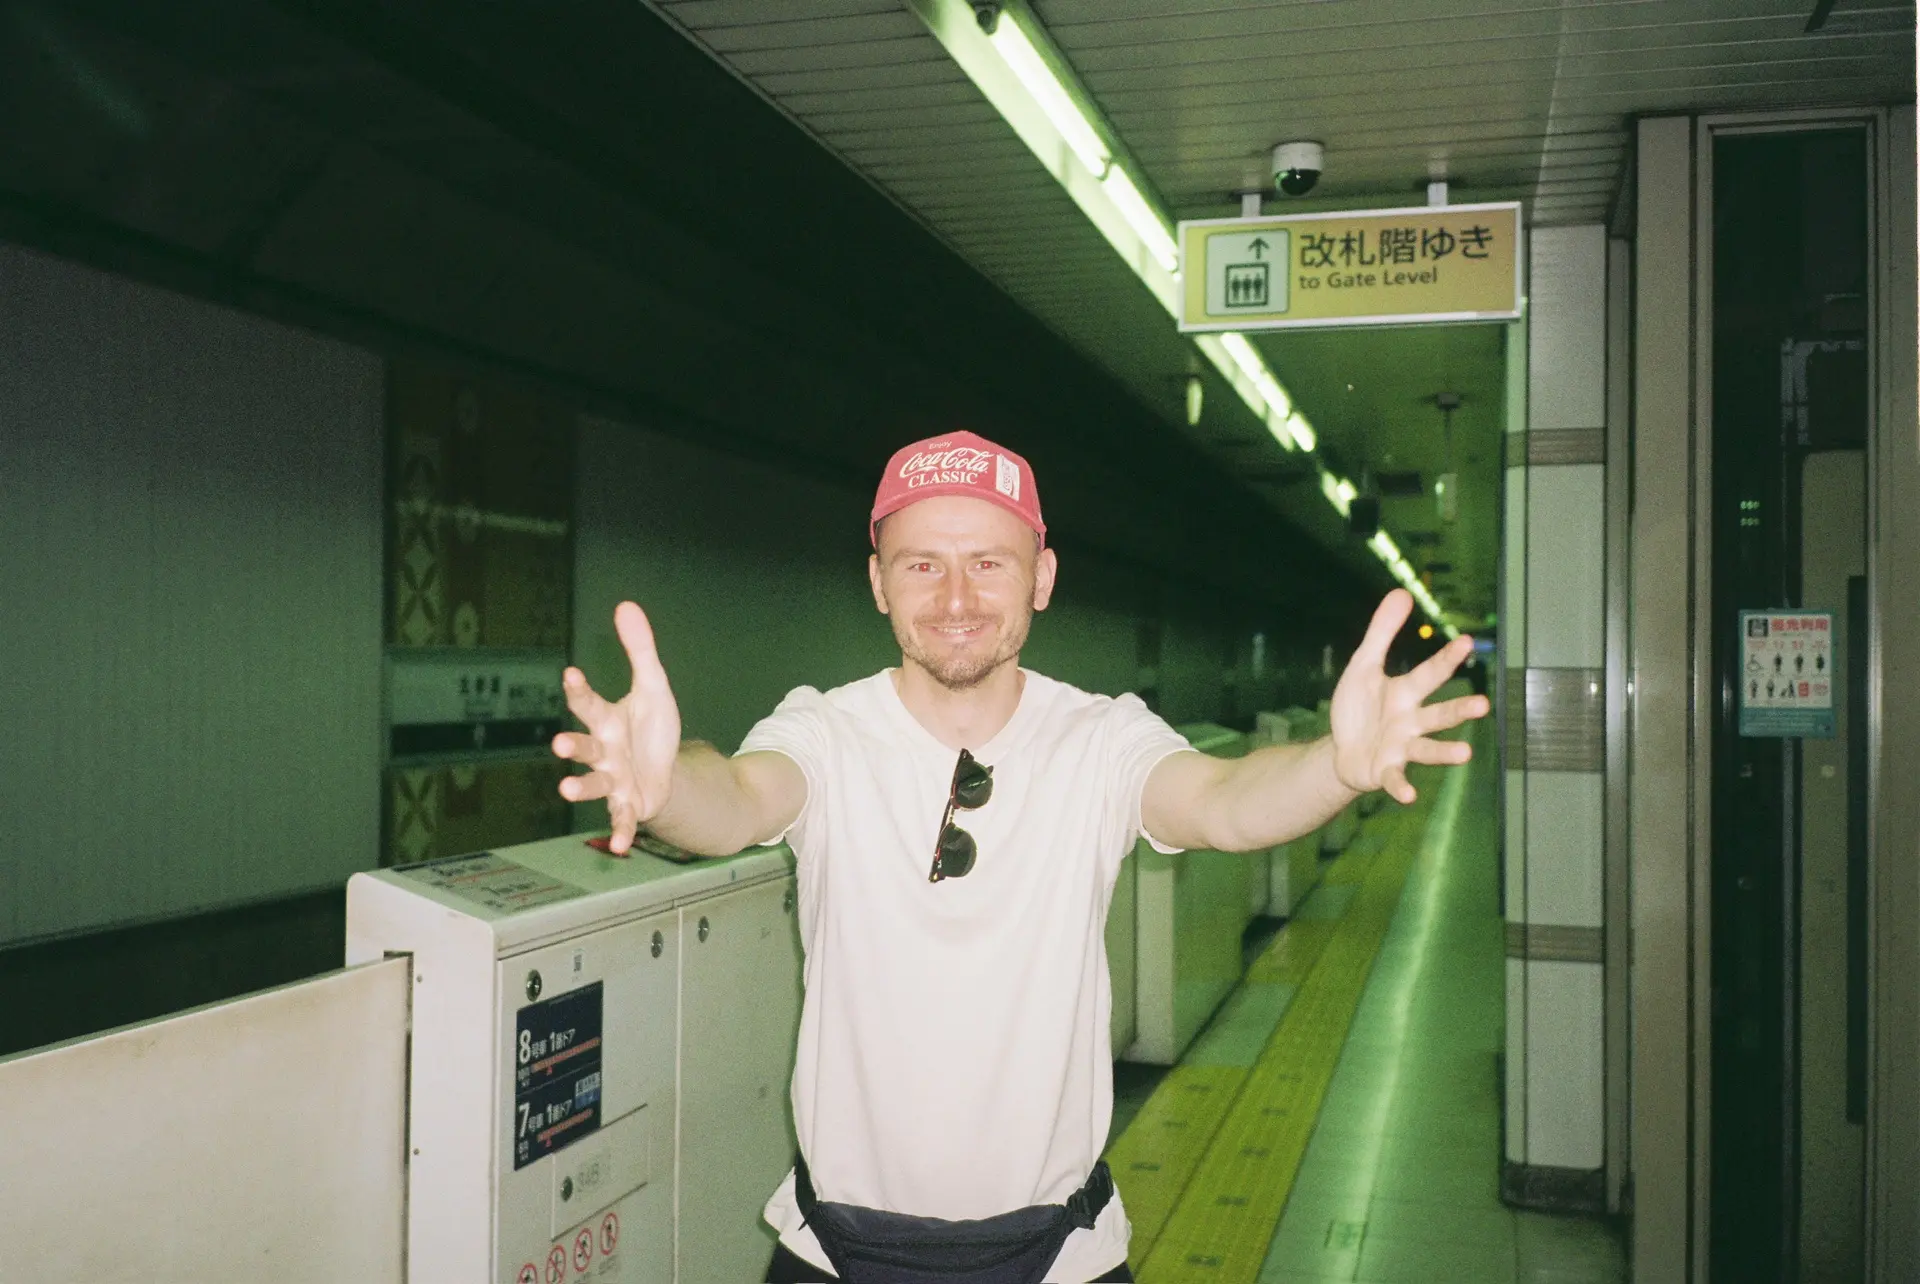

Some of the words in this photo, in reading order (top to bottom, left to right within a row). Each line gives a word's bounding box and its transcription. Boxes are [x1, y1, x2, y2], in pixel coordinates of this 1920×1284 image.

[1300, 225, 1493, 268] 改札階ゆき
[1299, 275, 1320, 289] to
[1327, 271, 1376, 288] Gate
[1383, 265, 1437, 285] Level
[929, 441, 952, 450] Enjoy
[900, 447, 994, 478] Coca-Cola
[908, 471, 978, 488] CLASSIC
